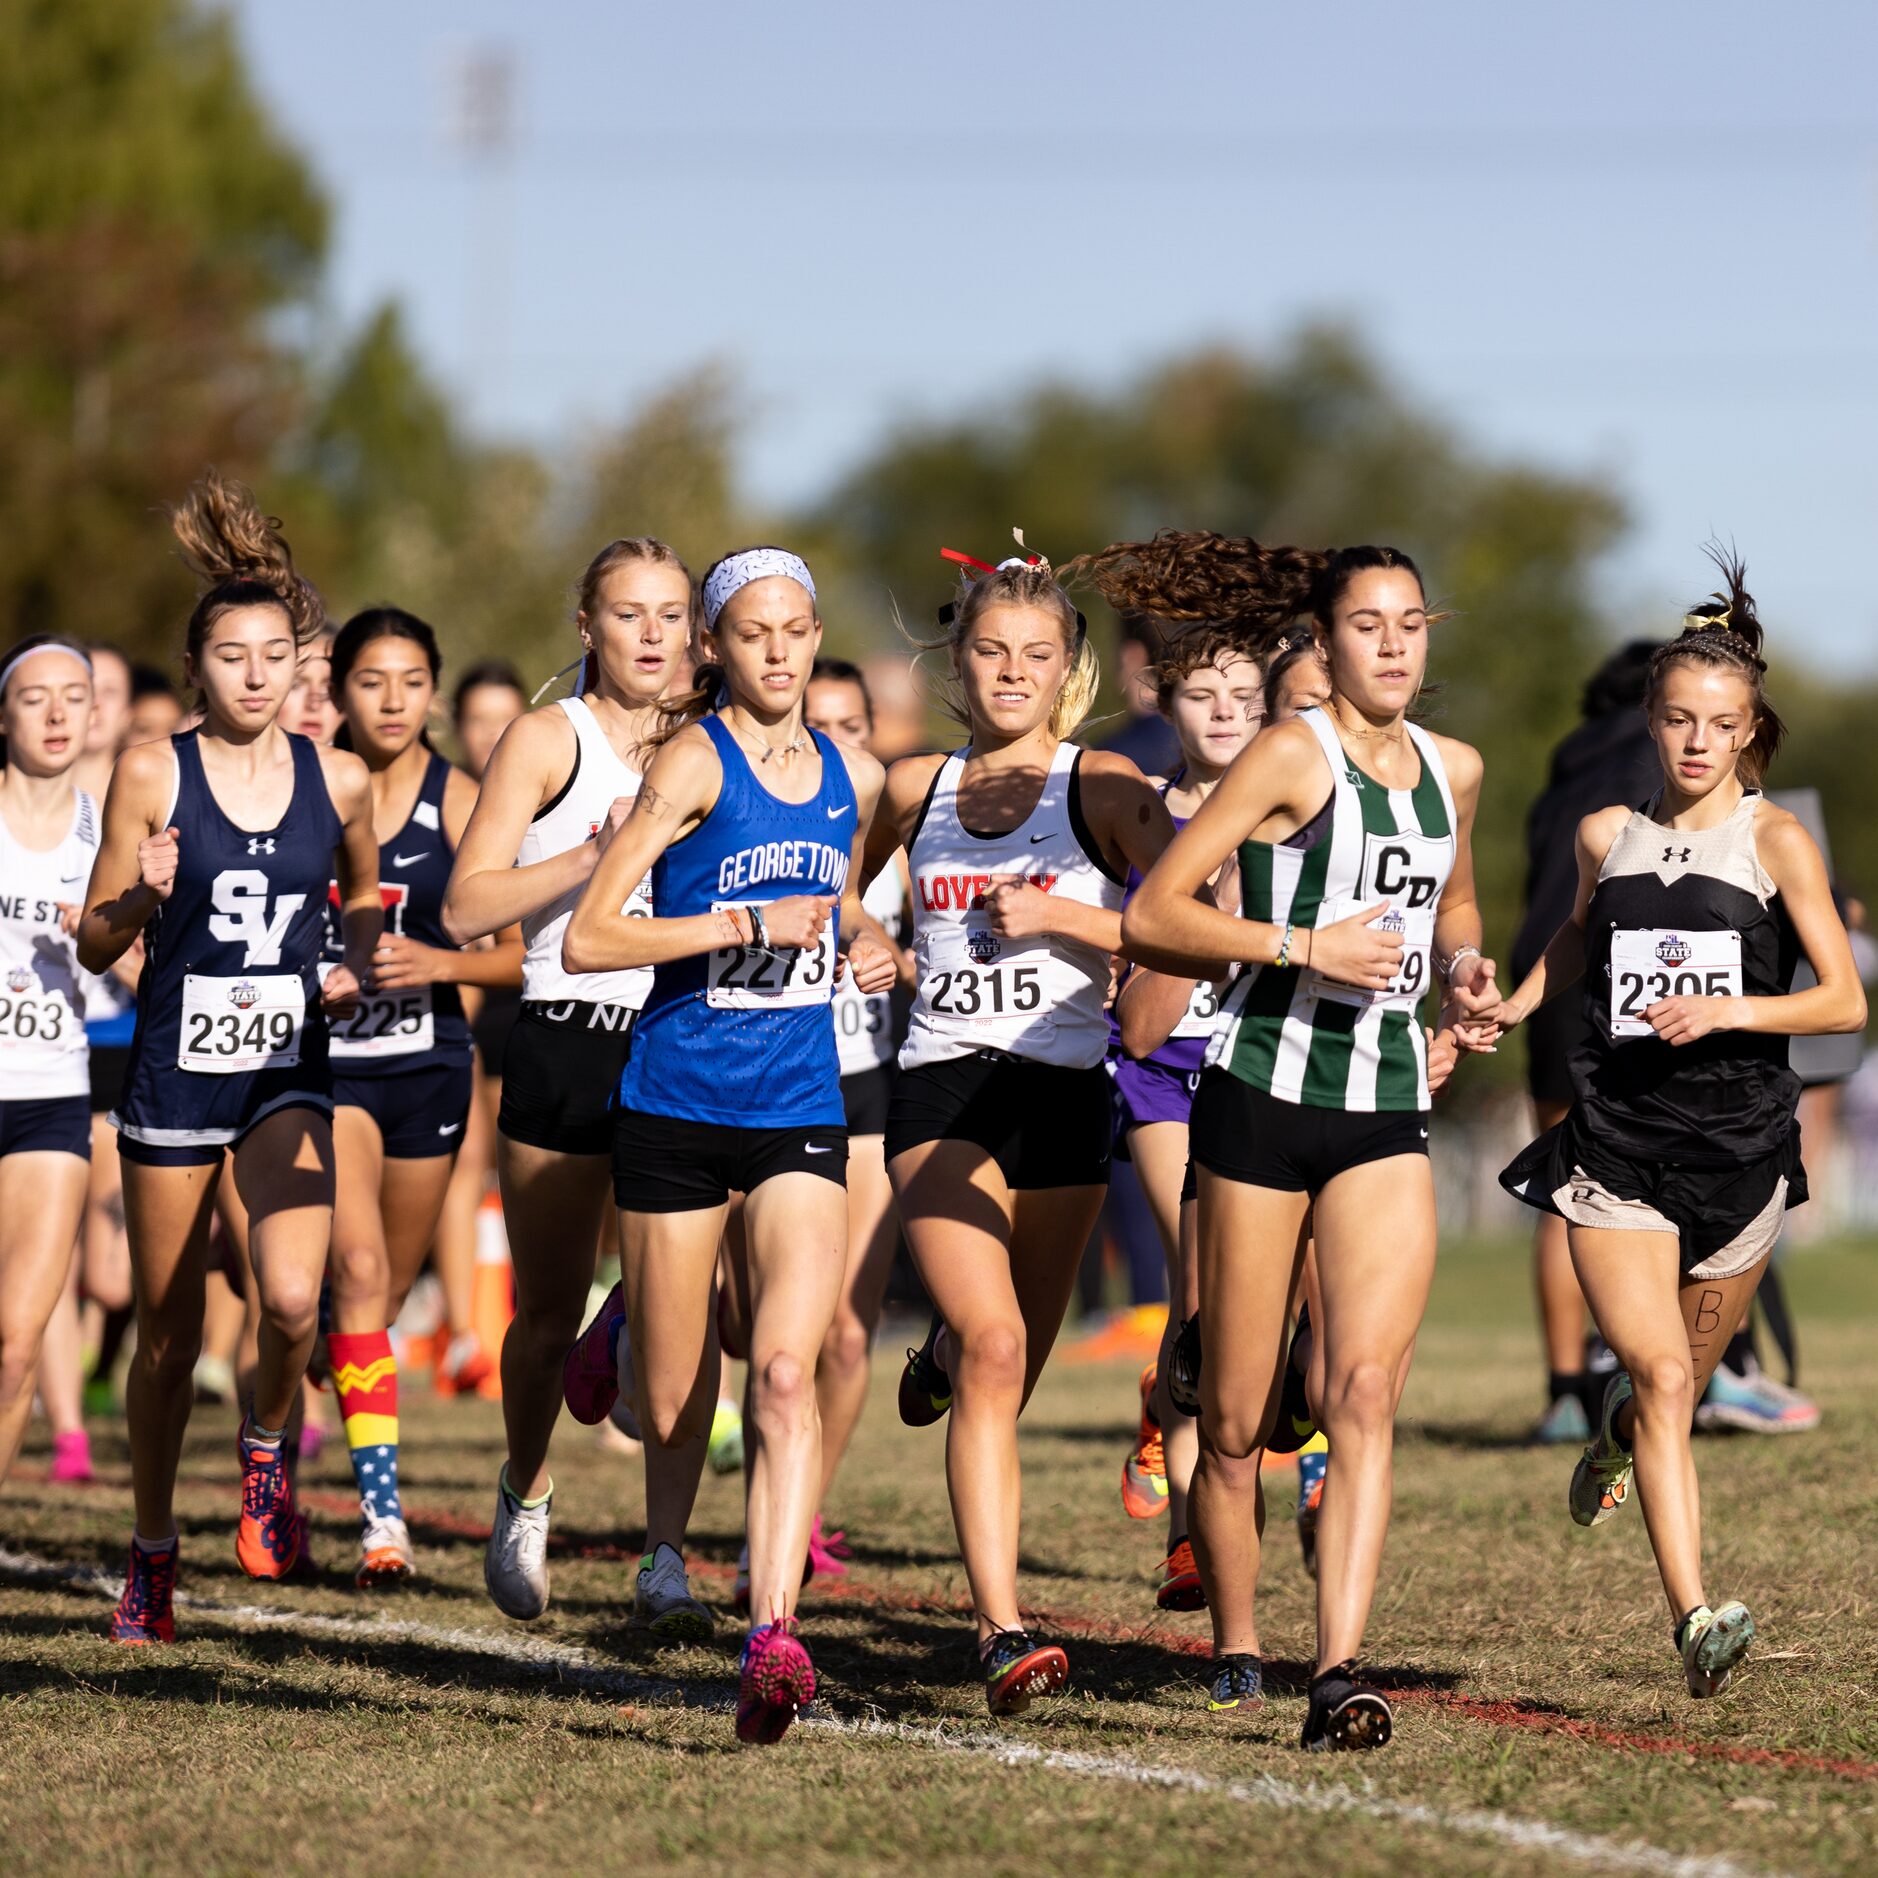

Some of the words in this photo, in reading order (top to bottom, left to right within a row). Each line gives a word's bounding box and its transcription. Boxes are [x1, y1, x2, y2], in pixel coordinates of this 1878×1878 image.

[918, 873, 1059, 912] LOVEY
[208, 869, 308, 969] SV
[964, 944, 1000, 954] STATE
[1656, 947, 1691, 957] STATE
[227, 991, 261, 1001] STATE
[929, 967, 1041, 1015] 2315
[1619, 971, 1732, 1016] 2305
[187, 1011, 294, 1056] 2349
[330, 998, 423, 1039] 225
[587, 1003, 640, 1032] NI
[975, 1019, 993, 1027] 2022
